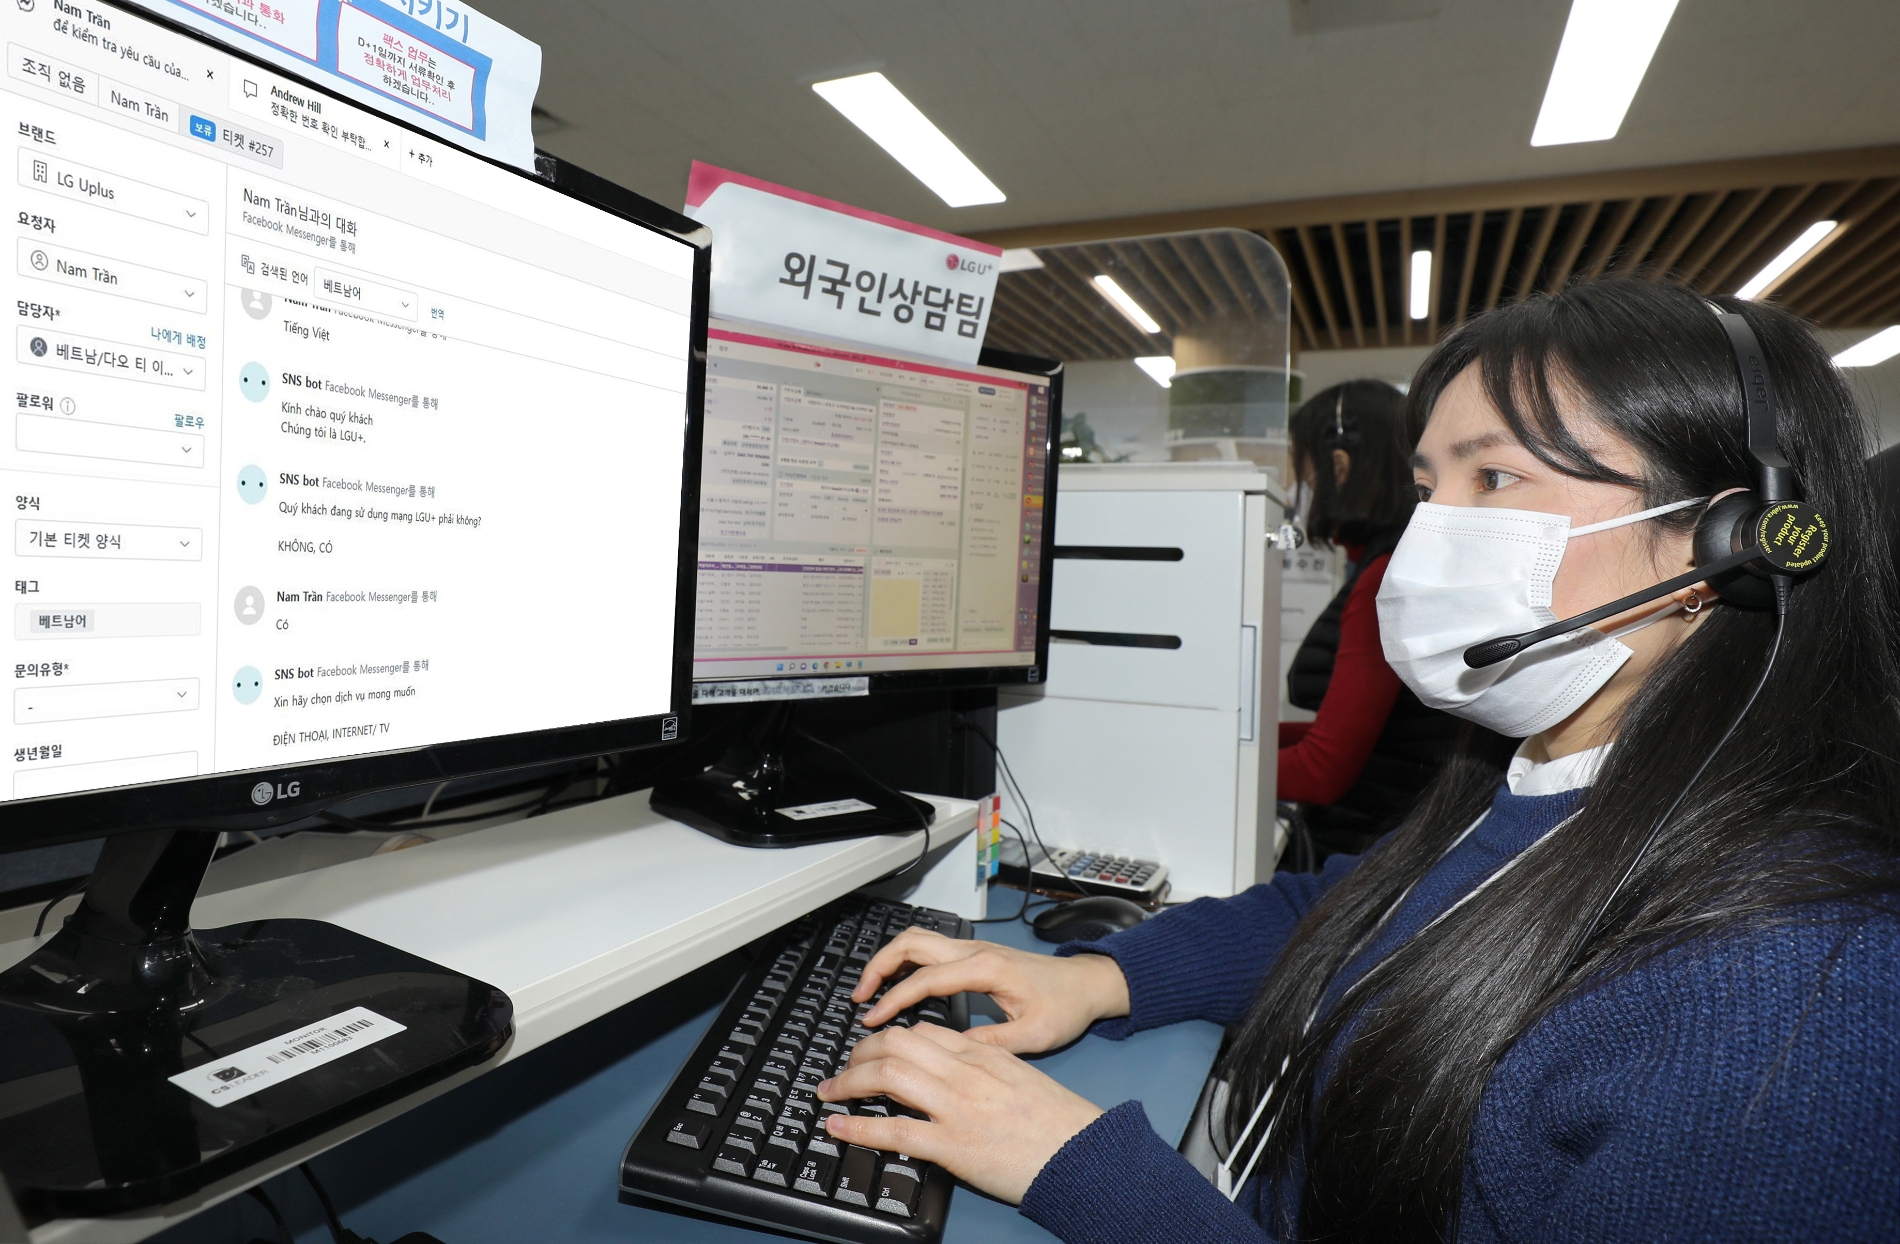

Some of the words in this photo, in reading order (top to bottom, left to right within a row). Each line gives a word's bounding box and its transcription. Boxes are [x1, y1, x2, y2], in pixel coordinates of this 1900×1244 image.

[54, 0, 82, 19] Nam
[87, 9, 111, 31] Trần
[259, 3, 285, 24] 통화
[402, 0, 468, 43] 키기
[53, 19, 69, 34] để
[72, 27, 99, 47] kiểm
[102, 37, 118, 53] tra
[120, 45, 140, 66] yêu
[142, 48, 161, 71] cầu
[382, 33, 404, 52] 팩스
[407, 45, 437, 70] 업무는
[357, 36, 406, 68] D+1일까지
[408, 62, 444, 86] 서류확인
[446, 80, 456, 91] 후
[21, 57, 51, 82] 조직
[58, 70, 86, 94] 없음
[363, 52, 407, 82] 정확하게
[410, 74, 451, 102] 업무처리
[111, 90, 140, 112] Nam
[145, 99, 169, 122] Trần
[271, 86, 305, 108] Andrew
[307, 98, 322, 114] Hill
[271, 101, 298, 122] 정확한
[302, 111, 319, 130] 번호
[322, 121, 338, 140] 확인
[17, 122, 56, 145] 브랜드
[223, 129, 245, 150] 티켓
[248, 140, 274, 158] #257
[418, 154, 433, 168] 추가
[57, 172, 74, 188] LG
[79, 177, 115, 200] Uplus
[17, 212, 56, 234] 요청자
[243, 188, 271, 209] Nam
[336, 217, 358, 238] 대화
[242, 211, 283, 233] Facebook
[340, 239, 356, 254] 통해
[56, 259, 87, 279] Nam
[92, 265, 118, 286] Trần
[261, 262, 288, 281] 검색된
[291, 270, 309, 286] 언어
[323, 278, 361, 300] 베트남어
[779, 252, 985, 339] 외국인상담팀
[430, 306, 445, 320] 번역
[151, 326, 182, 345] 나에게
[186, 334, 206, 350] 배정
[284, 319, 309, 339] Tiếng
[312, 327, 330, 341] Việt
[56, 342, 130, 370] 베트남/다오
[135, 356, 147, 373] 티
[281, 372, 302, 387] SNS
[305, 375, 322, 390] bot
[325, 380, 366, 398] Facebook
[16, 392, 54, 411] 팔로워
[281, 401, 302, 416] Kính
[305, 403, 327, 420] chào
[329, 406, 346, 424] quý
[348, 408, 373, 425] khách
[174, 413, 205, 430] 팔로우
[280, 421, 311, 439] Chúng
[314, 424, 327, 438] tôi
[329, 427, 337, 439] là
[340, 429, 366, 443] LGU+.
[279, 472, 299, 486] SNS
[303, 474, 319, 488] bot
[322, 477, 363, 492] Facebook
[15, 495, 41, 511] 양식
[278, 501, 298, 517] Quý
[301, 501, 327, 516] khách
[330, 504, 352, 520] đang
[355, 505, 365, 518] sử
[367, 507, 388, 522] dụng
[391, 511, 413, 523] mạng
[415, 511, 436, 523] LGU+
[438, 512, 454, 526] phải
[456, 513, 482, 528] không?
[29, 531, 58, 548] 기본
[64, 531, 90, 549] 티켓
[95, 533, 121, 550] 양식
[1774, 513, 1796, 546] product
[1787, 525, 1802, 545] your
[1793, 524, 1818, 558] Register
[1821, 528, 1829, 542] your
[278, 538, 316, 555] KHÔNG,
[319, 540, 333, 554] CÓ
[1812, 542, 1828, 563] product
[1785, 559, 1812, 568] updated
[15, 580, 40, 595] 태그
[277, 591, 300, 602] Nam
[303, 590, 323, 602] Trần
[326, 591, 366, 602] Facebook
[38, 614, 87, 629] 베트남어
[276, 618, 289, 630] Có
[274, 668, 295, 680] SNS
[298, 667, 314, 679] bot
[317, 664, 357, 678] Facebook
[274, 695, 289, 708] Xin
[292, 694, 308, 708] hãy
[311, 692, 332, 706] chọn
[335, 691, 353, 703] dịch
[355, 691, 366, 702] vụ
[368, 689, 391, 702] mong
[394, 685, 416, 698] muốn
[273, 732, 296, 746] ĐIỆN
[299, 729, 329, 744] THOẠI,
[332, 725, 377, 739] INTERNET/
[379, 723, 390, 734] TV
[14, 744, 62, 762] 생년월일
[277, 781, 300, 800] LG
[284, 1027, 327, 1045] MONITOR
